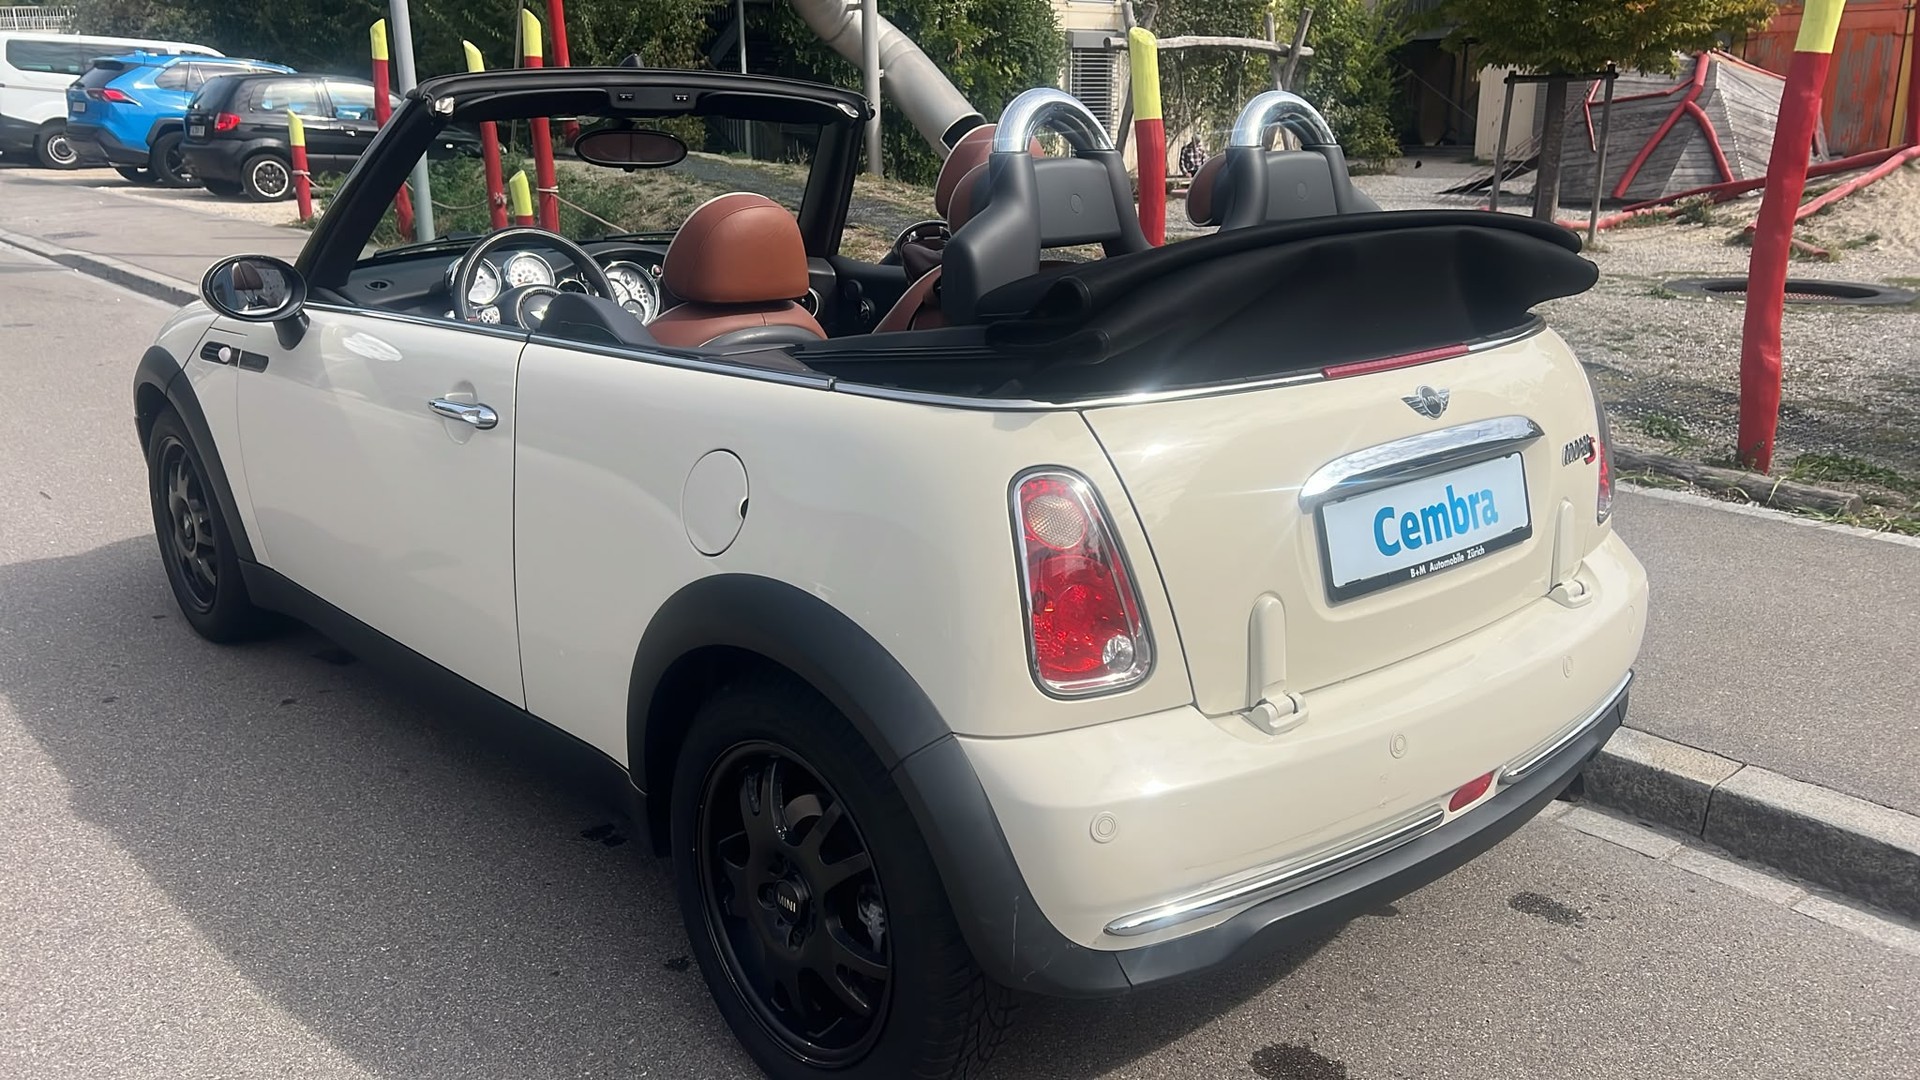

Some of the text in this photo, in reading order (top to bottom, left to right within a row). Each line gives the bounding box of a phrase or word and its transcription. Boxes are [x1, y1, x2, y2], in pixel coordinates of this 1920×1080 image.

[1374, 485, 1498, 556] Cembra
[1410, 545, 1485, 578] B+M Automobile Zürich
[777, 892, 796, 912] MINI
